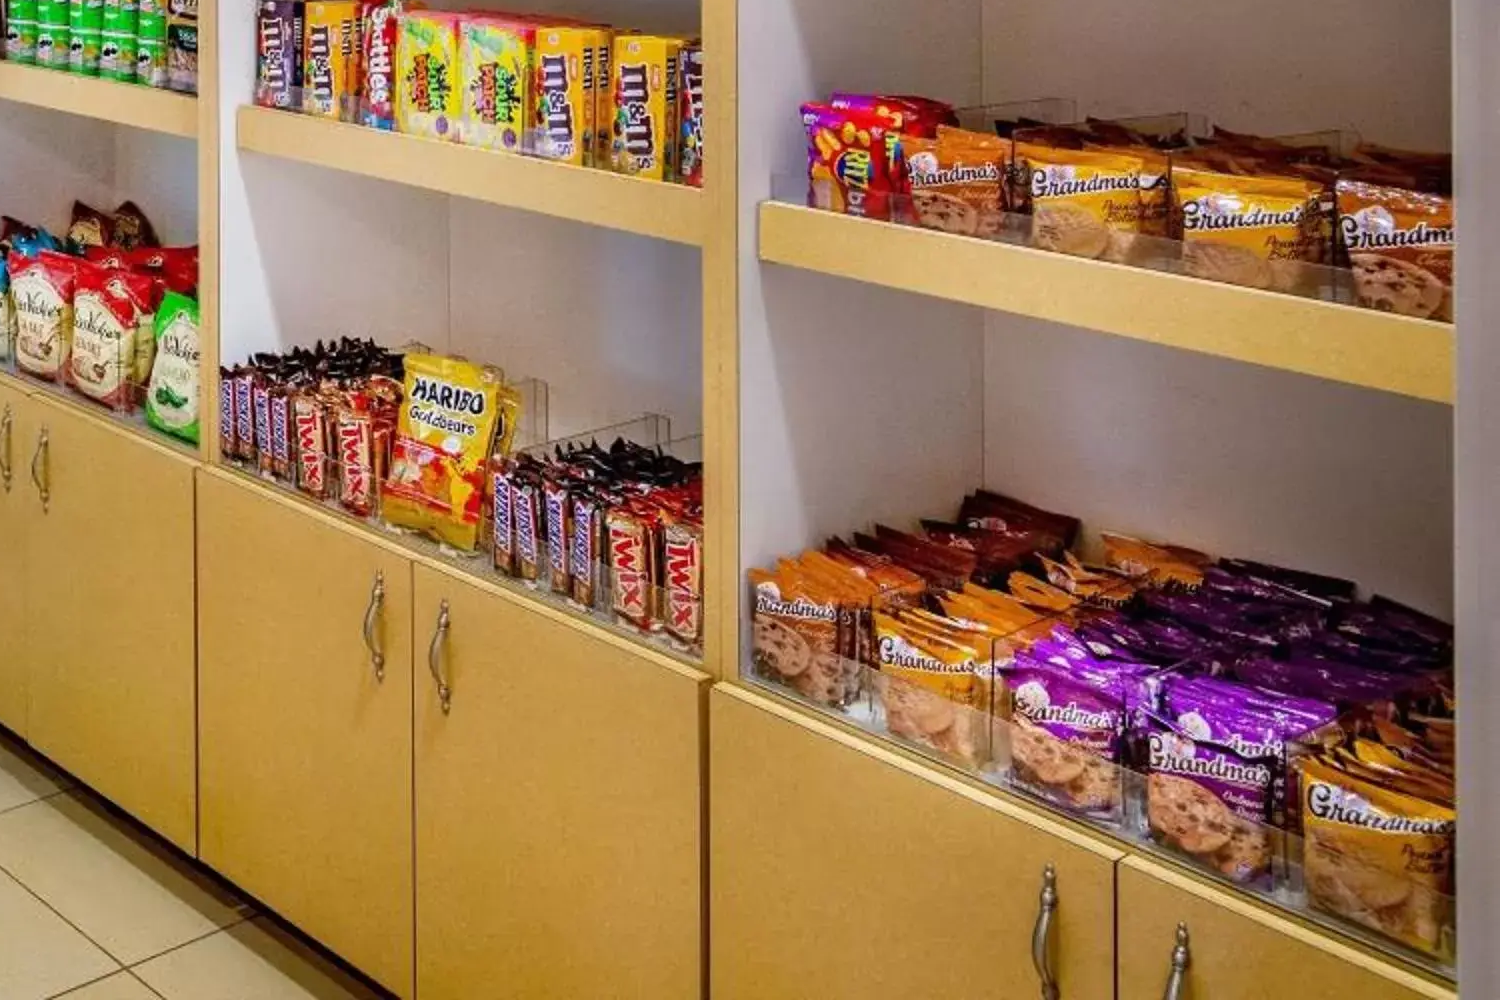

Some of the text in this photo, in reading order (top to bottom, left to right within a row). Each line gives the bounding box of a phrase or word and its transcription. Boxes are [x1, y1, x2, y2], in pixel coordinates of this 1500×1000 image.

[369, 7, 391, 104] Skittles
[1031, 168, 1140, 198] Grandma's
[411, 377, 485, 415] HARIBO
[409, 405, 475, 437] Goldbears
[1149, 734, 1271, 786] Grandma's
